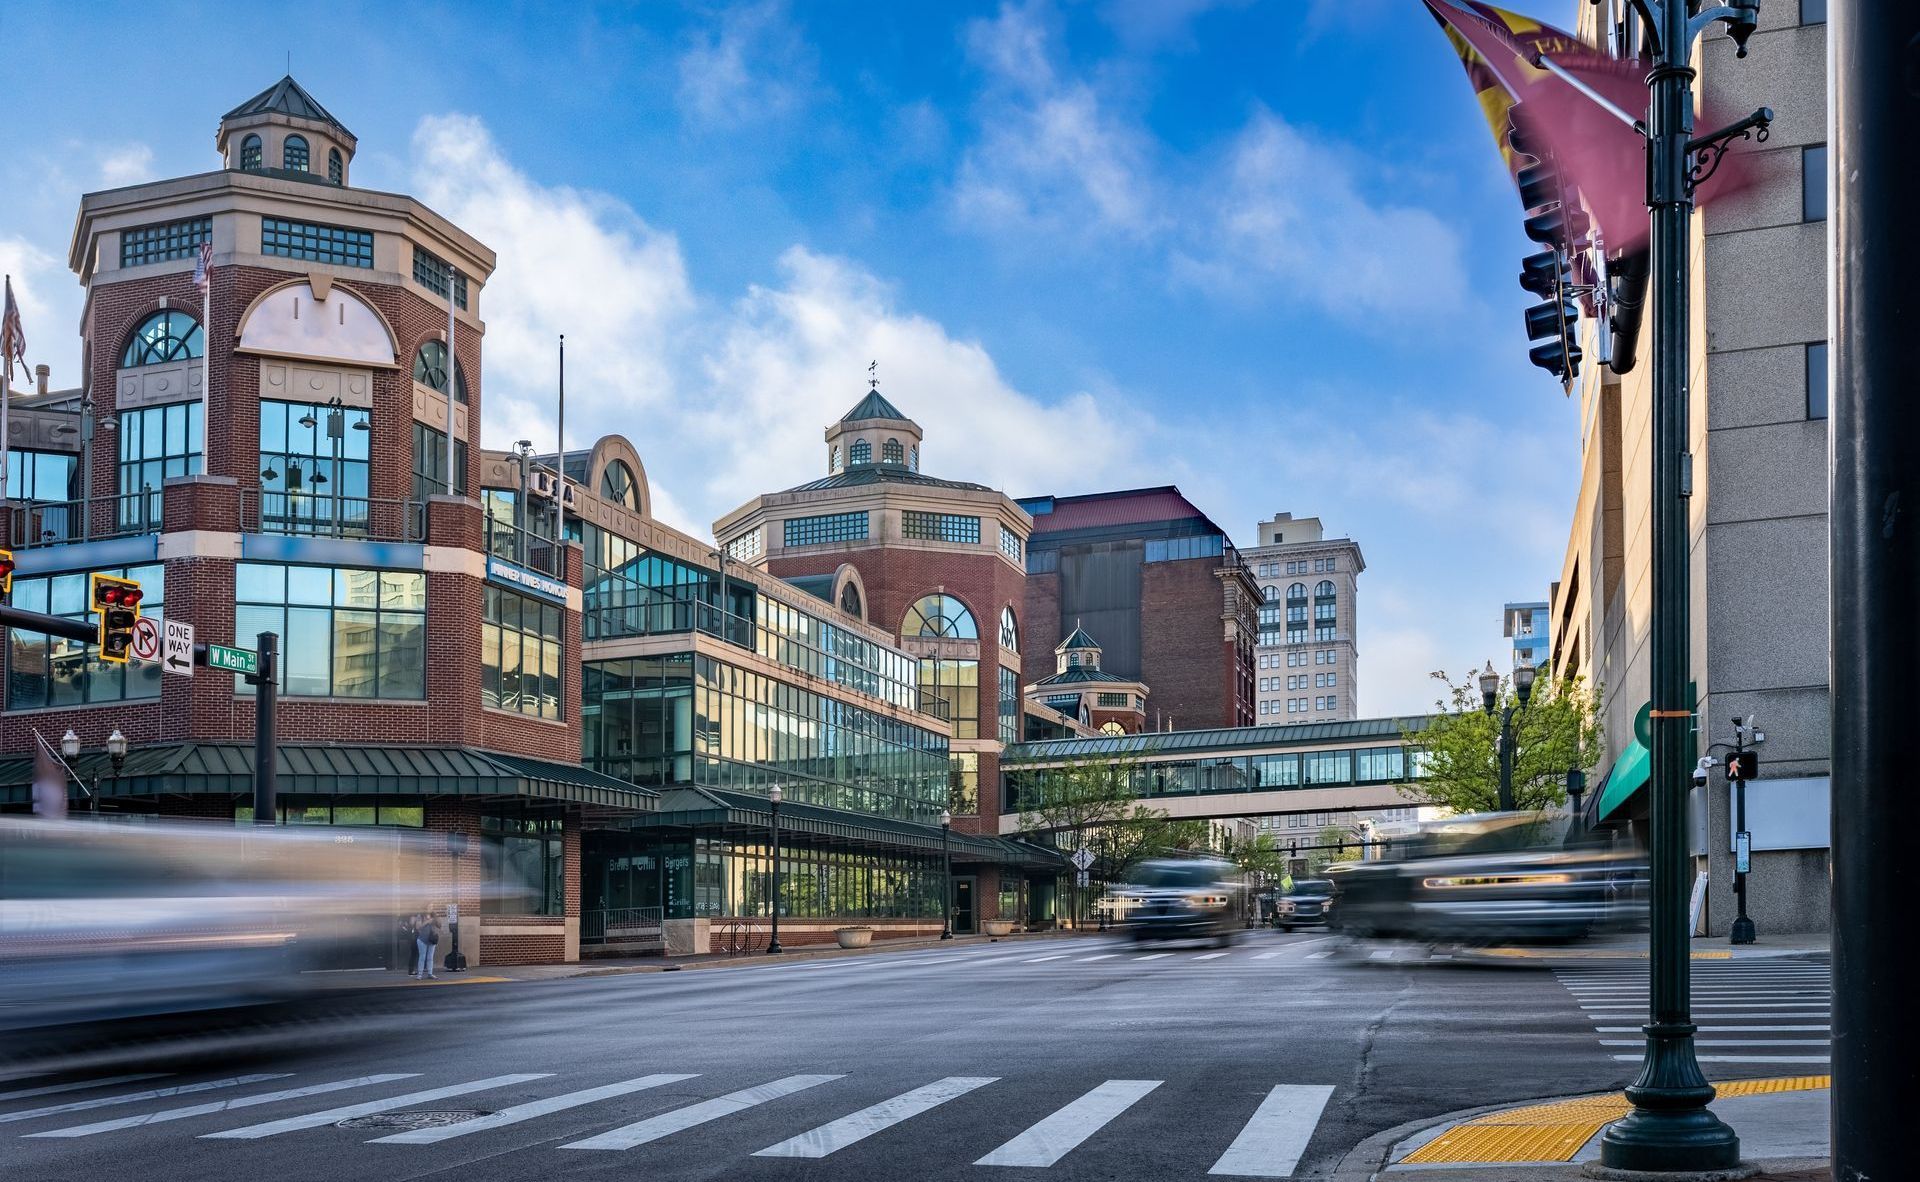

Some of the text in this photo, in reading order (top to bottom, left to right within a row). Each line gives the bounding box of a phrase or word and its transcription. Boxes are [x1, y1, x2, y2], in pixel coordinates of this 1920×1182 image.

[168, 624, 190, 640] ONE
[168, 639, 191, 654] WAY
[212, 648, 254, 669] W Main St
